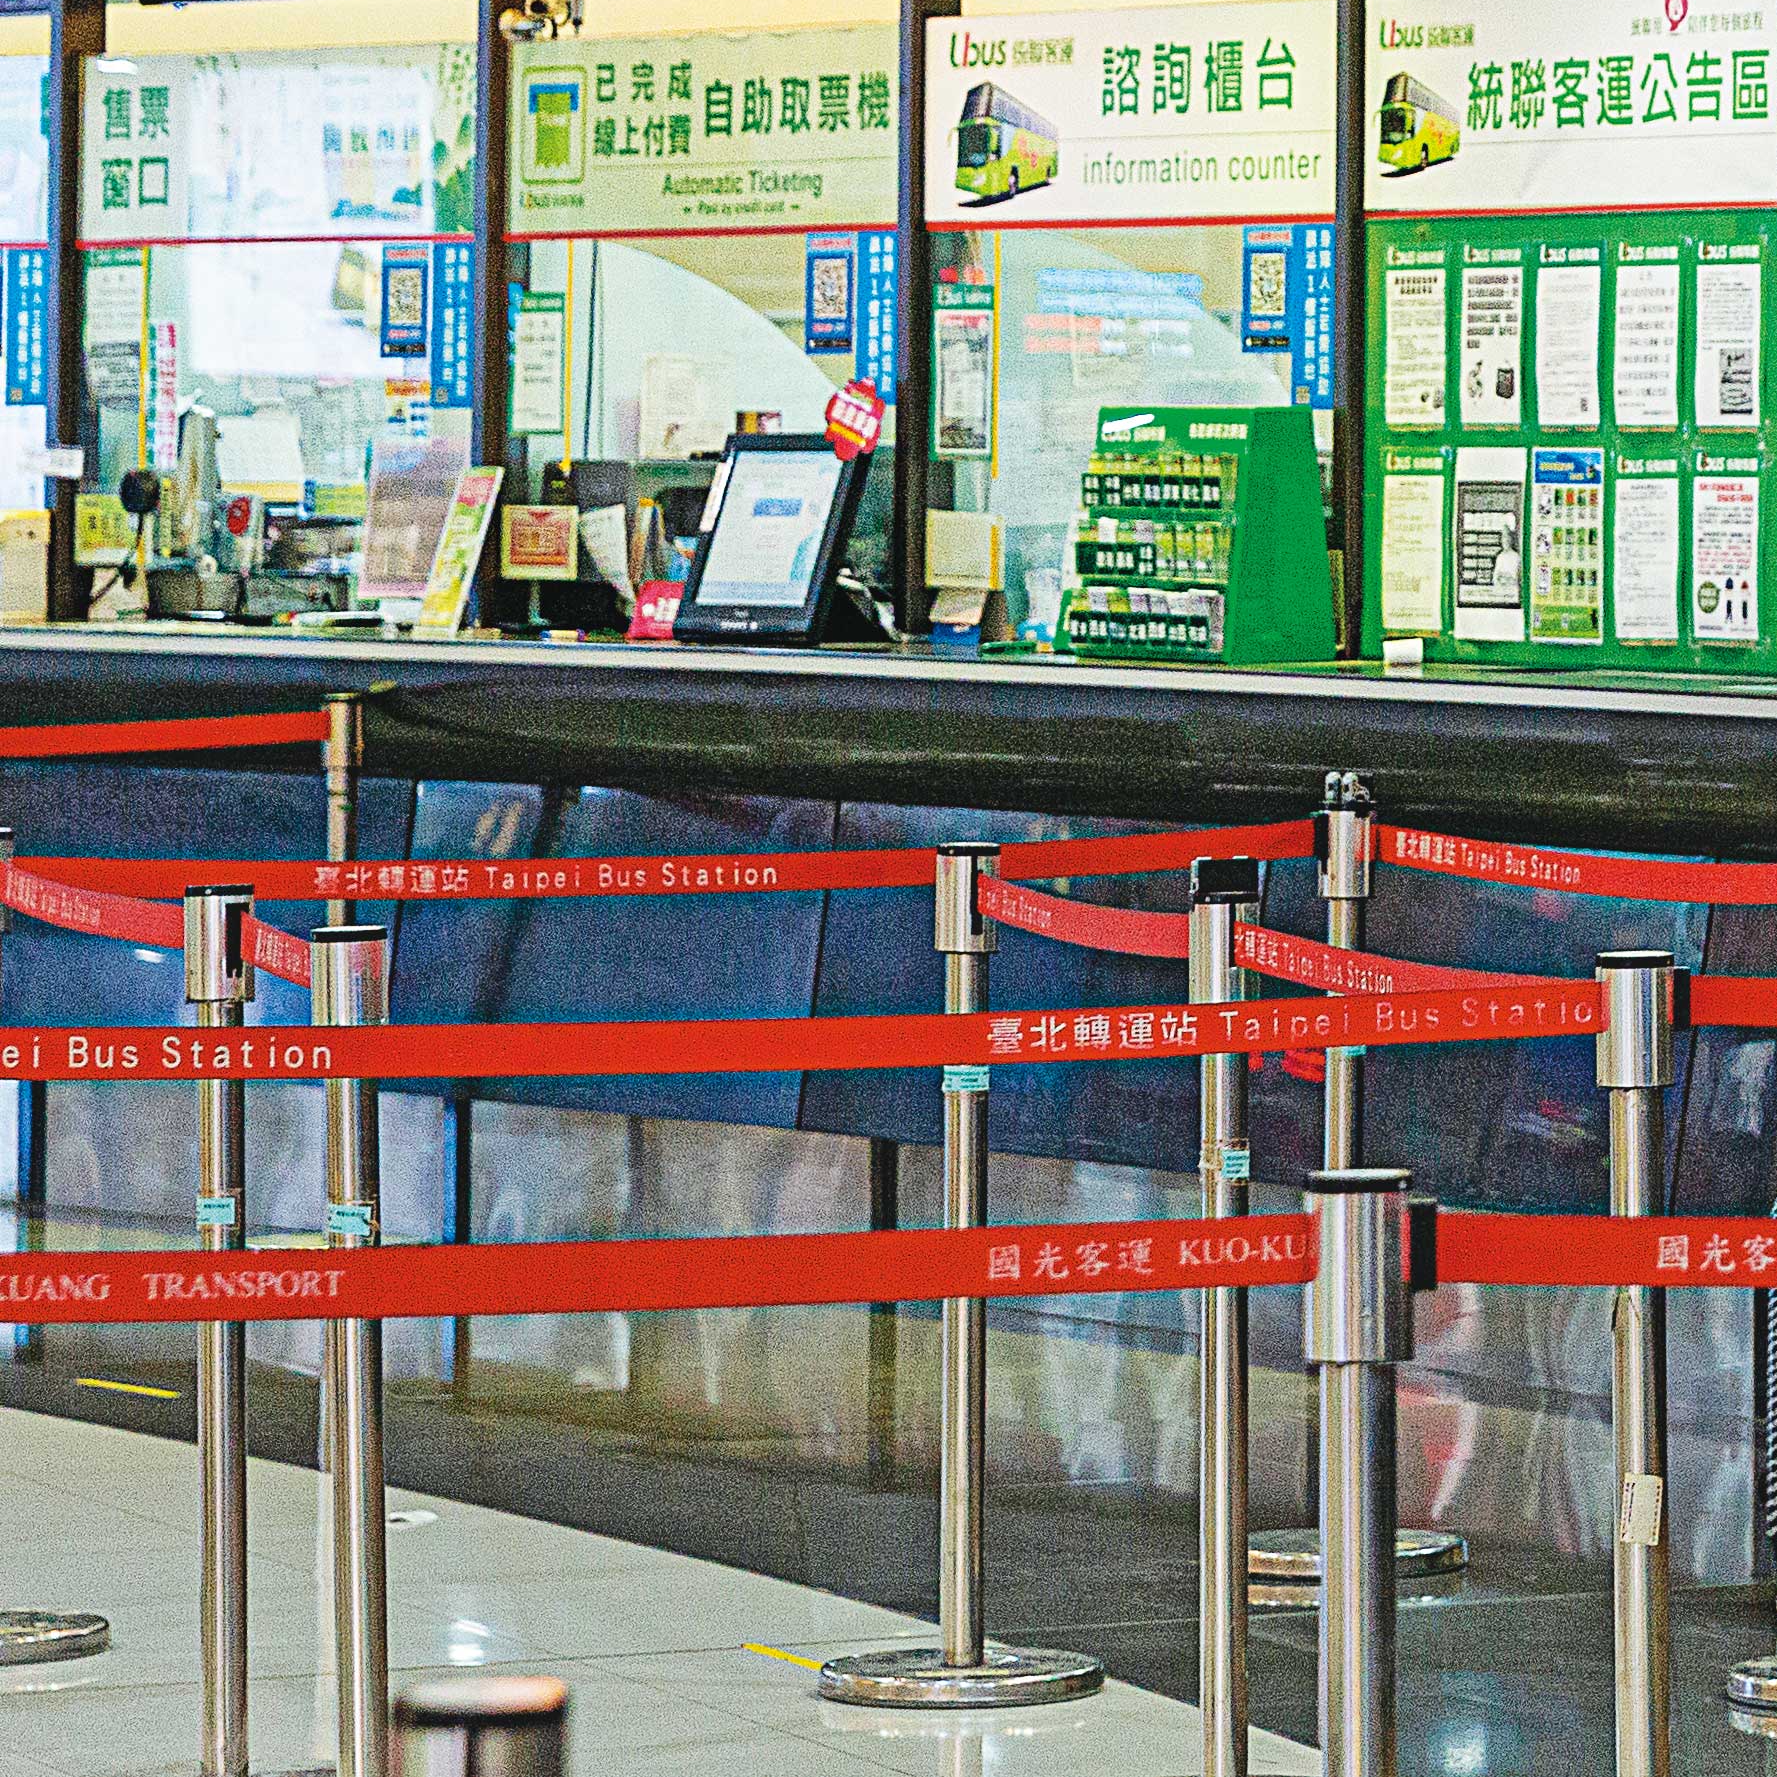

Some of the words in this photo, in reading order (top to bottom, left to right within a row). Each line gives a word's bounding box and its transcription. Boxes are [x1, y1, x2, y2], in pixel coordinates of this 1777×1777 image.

[596, 62, 691, 103] 已完成
[1101, 37, 1297, 117] 諮詢櫃台
[1467, 47, 1770, 132] 統聯客運公告區
[103, 86, 169, 139] 售票
[594, 115, 690, 156] 線上付費
[704, 71, 891, 139] 自助取票機
[663, 171, 743, 196] Automatic
[748, 169, 823, 198] Ticketing
[1083, 150, 1217, 186] information
[1229, 148, 1321, 181] counter
[314, 864, 469, 894] 臺北轉運站
[485, 866, 581, 892] Taipei
[599, 865, 648, 889] Bus
[662, 862, 778, 888] Station
[1504, 847, 1527, 877] Bus
[1530, 851, 1582, 884] Station
[1347, 956, 1393, 995] Station
[987, 1012, 1199, 1057] 臺北轉運站
[1222, 1007, 1351, 1044] Taipei
[1376, 1000, 1440, 1033] Bus
[69, 1036, 138, 1068] Bus
[161, 1036, 331, 1071] Station
[988, 1237, 1153, 1281] 國光客運
[144, 1271, 343, 1299] TRANSPORT
